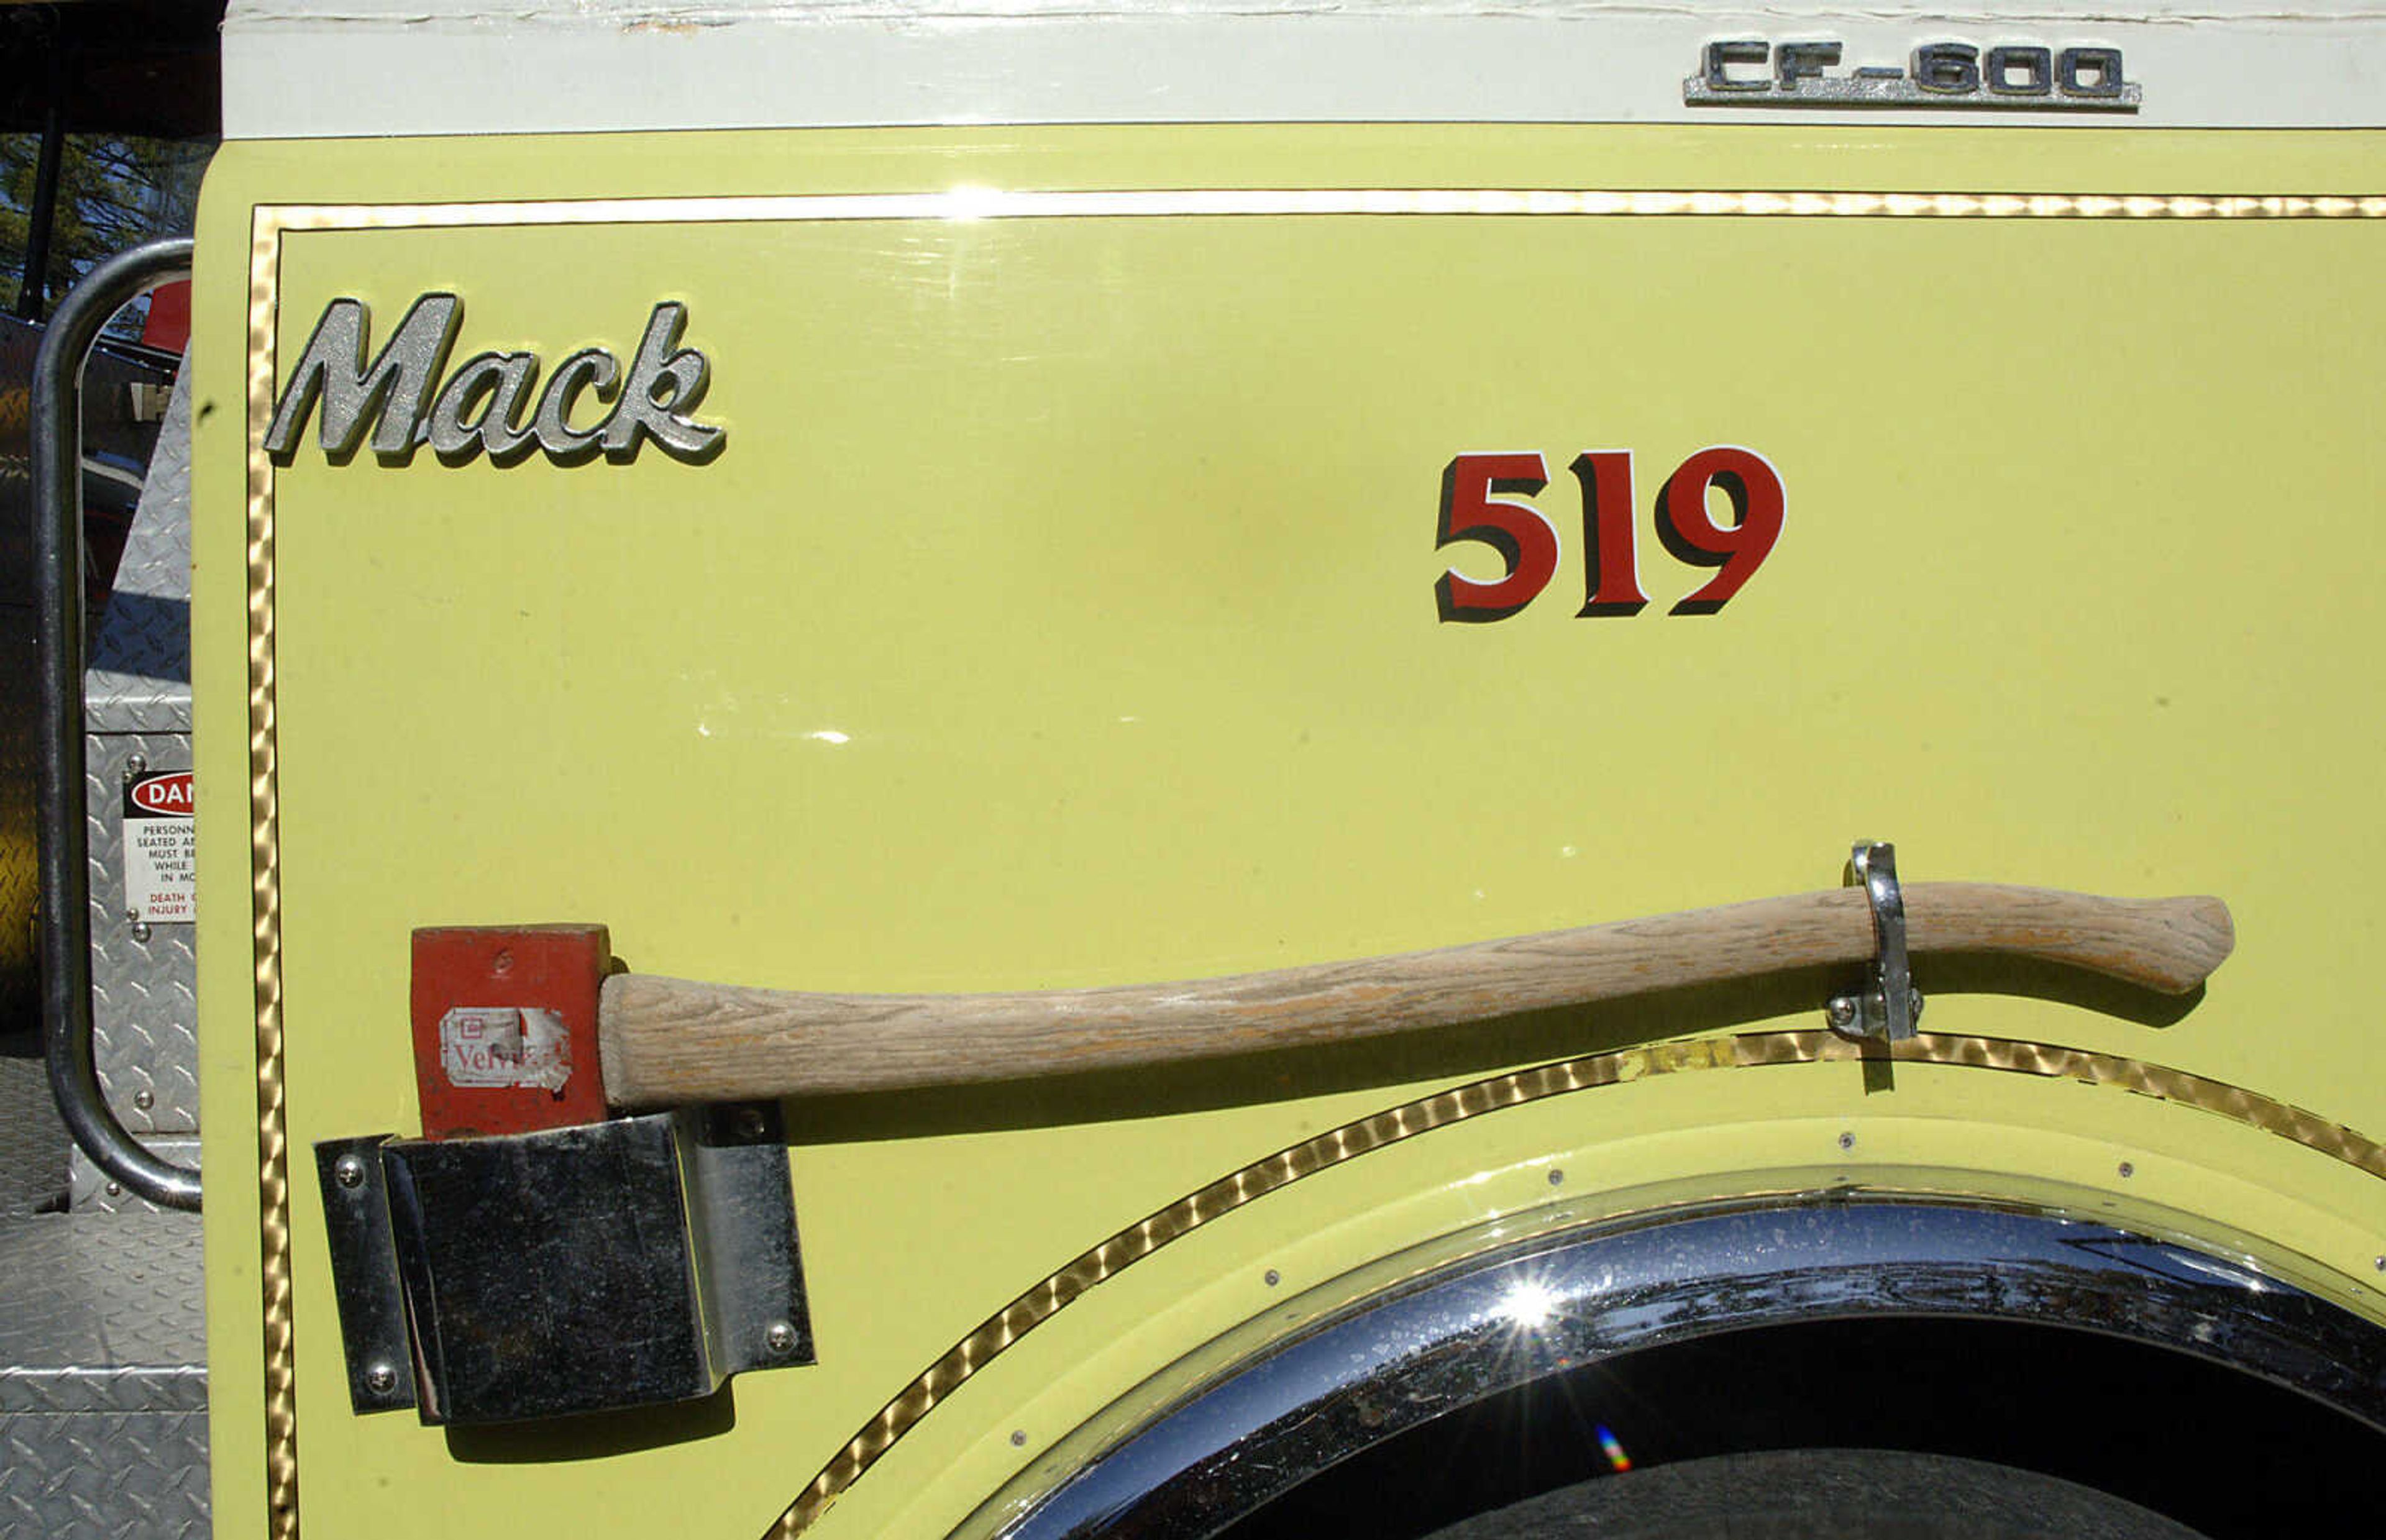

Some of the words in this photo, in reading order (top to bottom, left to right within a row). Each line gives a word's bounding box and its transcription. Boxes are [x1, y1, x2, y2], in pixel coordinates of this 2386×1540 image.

[263, 291, 726, 467] Mack
[1434, 444, 1788, 623] 519
[137, 837, 176, 847] SEATED
[149, 849, 177, 858] MUST
[155, 860, 186, 870] WHILE
[161, 873, 173, 882] IN
[150, 893, 185, 903] DEATH
[149, 904, 188, 914] INJURY
